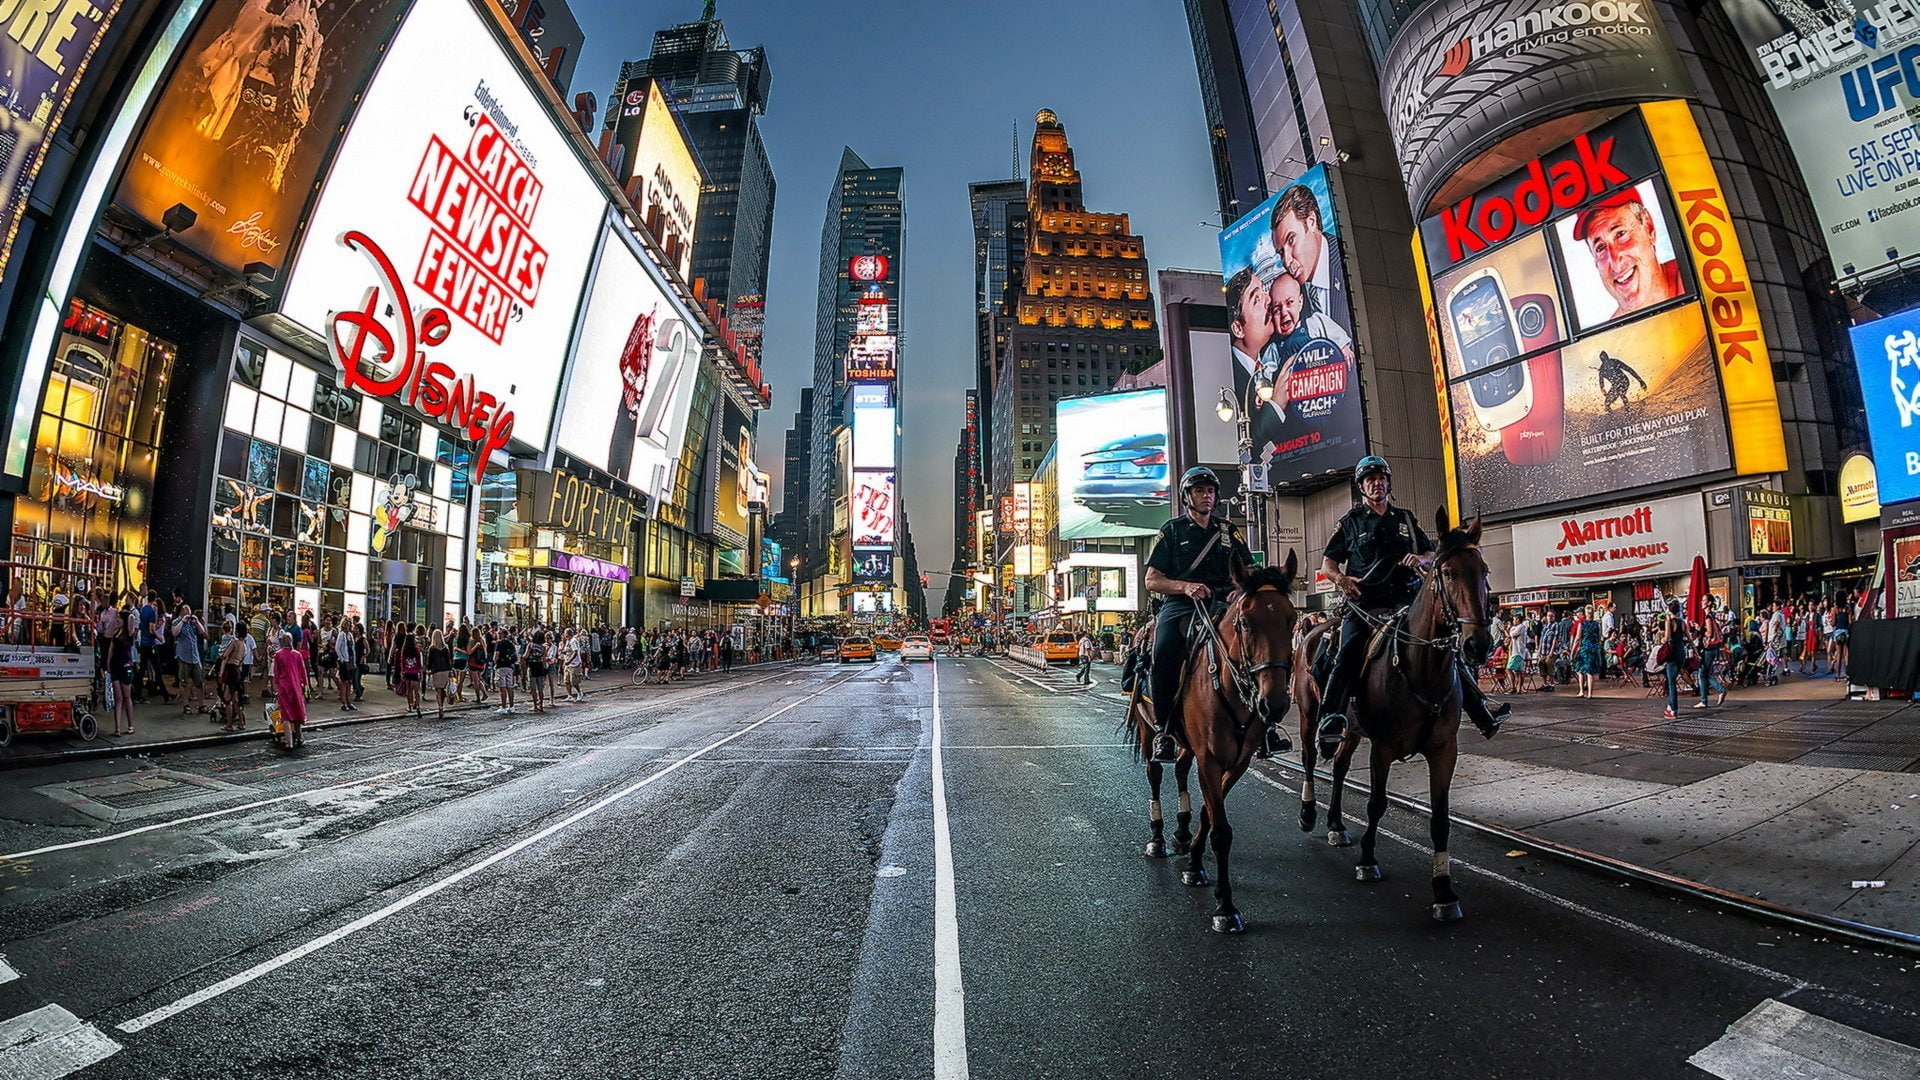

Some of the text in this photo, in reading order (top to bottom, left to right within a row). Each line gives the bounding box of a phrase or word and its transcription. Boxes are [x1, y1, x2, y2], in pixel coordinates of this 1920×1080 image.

[1506, 23, 1651, 58] driving emotion
[1756, 31, 1798, 58] JON JONES
[1760, 19, 1863, 90] BONES
[1856, 24, 1876, 42] VS
[474, 78, 519, 138] Entertainment
[624, 107, 640, 117] LG
[1849, 140, 1884, 168] SAT.
[1837, 166, 1877, 197] LIVE
[1877, 157, 1903, 182] ON
[655, 162, 692, 233] AND ONLY
[1440, 134, 1631, 263] Kodak
[409, 137, 547, 301] NEWSIES
[1831, 218, 1861, 235] UFC.COM
[1678, 188, 1759, 367] Kodak
[1303, 347, 1329, 363] WILL
[848, 369, 895, 378] TOSHIBA
[1291, 370, 1344, 399] CAMPAIGN
[1302, 396, 1331, 413] ZACH
[1581, 406, 1709, 447] BUILT FOR THE WAY YOU PLAY.
[1274, 435, 1310, 455] AUGUST
[1310, 431, 1321, 444] 10
[1745, 490, 1790, 506] MARQUIS
[1846, 480, 1874, 497] Marriott
[549, 469, 634, 546] FOREVER
[1556, 506, 1652, 550] Marriott
[1545, 542, 1669, 568] NEW YORK MARQUIS
